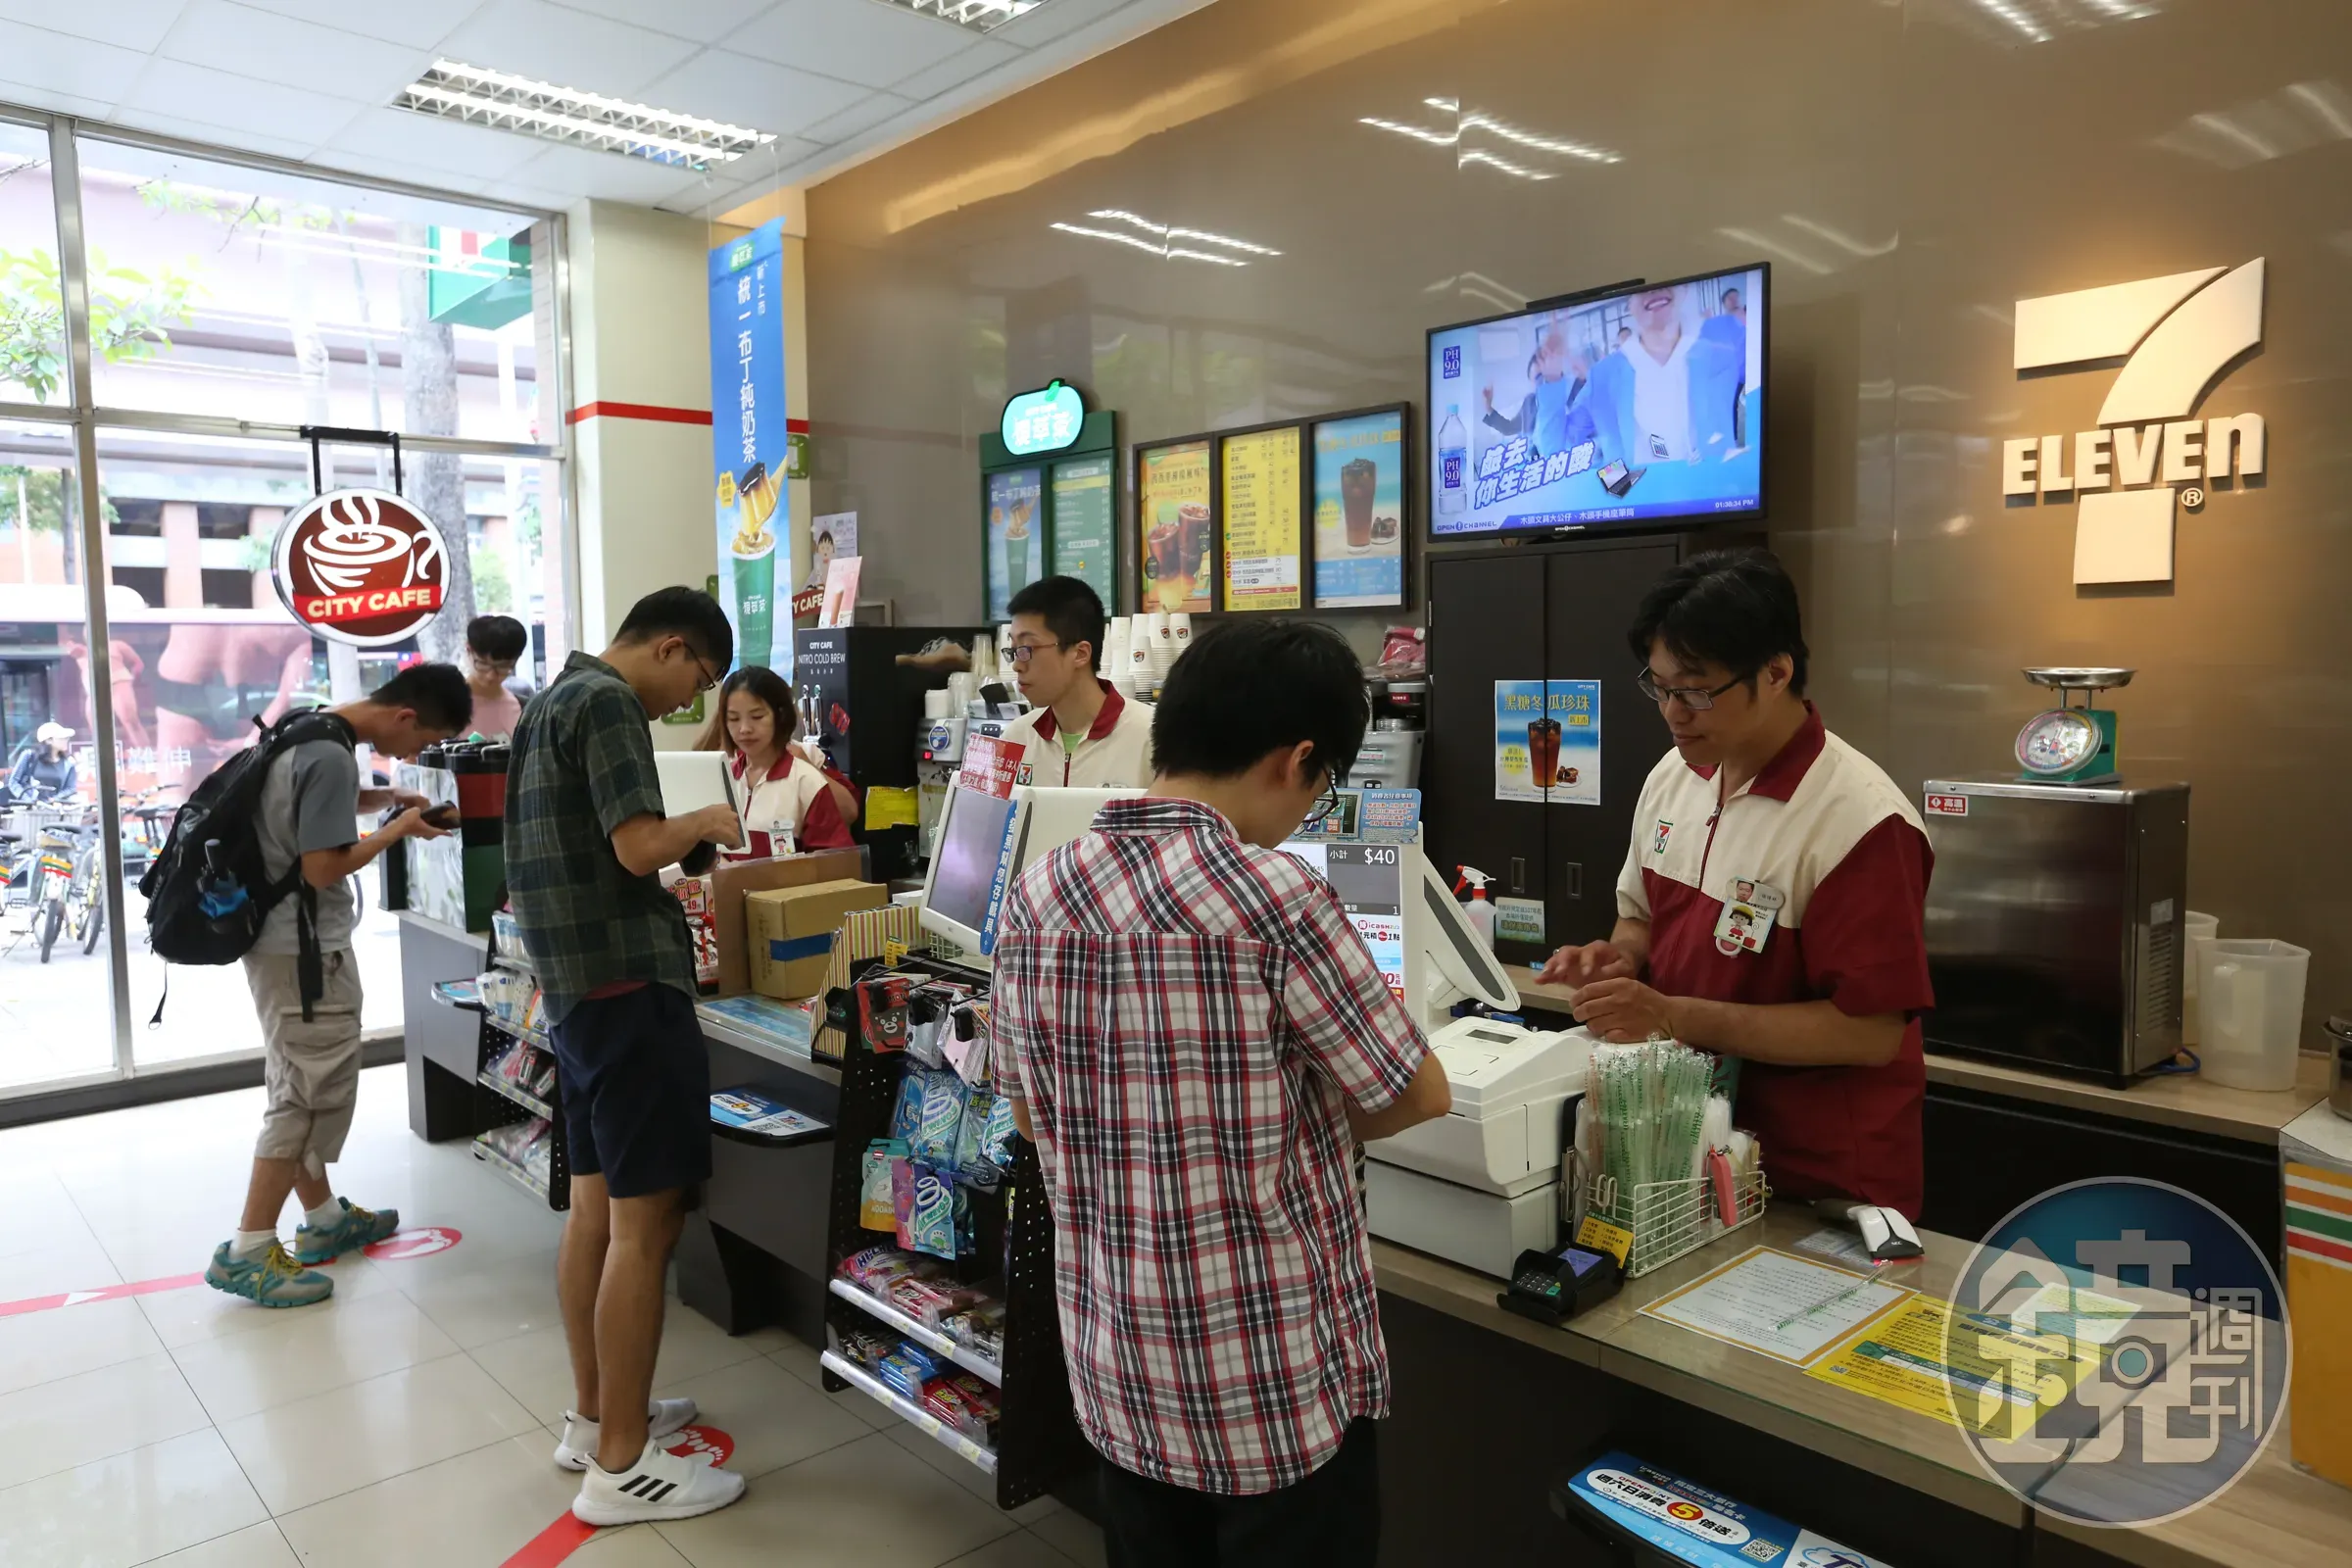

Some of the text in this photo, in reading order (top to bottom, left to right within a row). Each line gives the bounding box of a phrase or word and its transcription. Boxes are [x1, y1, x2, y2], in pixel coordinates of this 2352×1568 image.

[1445, 349, 1459, 360] PH
[737, 275, 758, 464] 統一布丁純奶茶
[1444, 359, 1460, 371] 9.0
[2014, 257, 2265, 584] 7
[1446, 461, 1459, 470] PH
[1475, 441, 1595, 510] 你生活的酸
[307, 588, 431, 618] CITY CAFE
[800, 593, 823, 612] CAFE
[798, 653, 846, 664] NITRO COLD BREW
[1504, 694, 1591, 711] 黑糖冬瓜珍珠
[1329, 847, 1396, 865] 小計 $40
[687, 900, 698, 910] 49
[1344, 904, 1399, 915] 數量 1
[1595, 1473, 1668, 1507] 週六日消費
[1672, 1502, 1701, 1519] 5
[1698, 1518, 1733, 1537] 倍送
